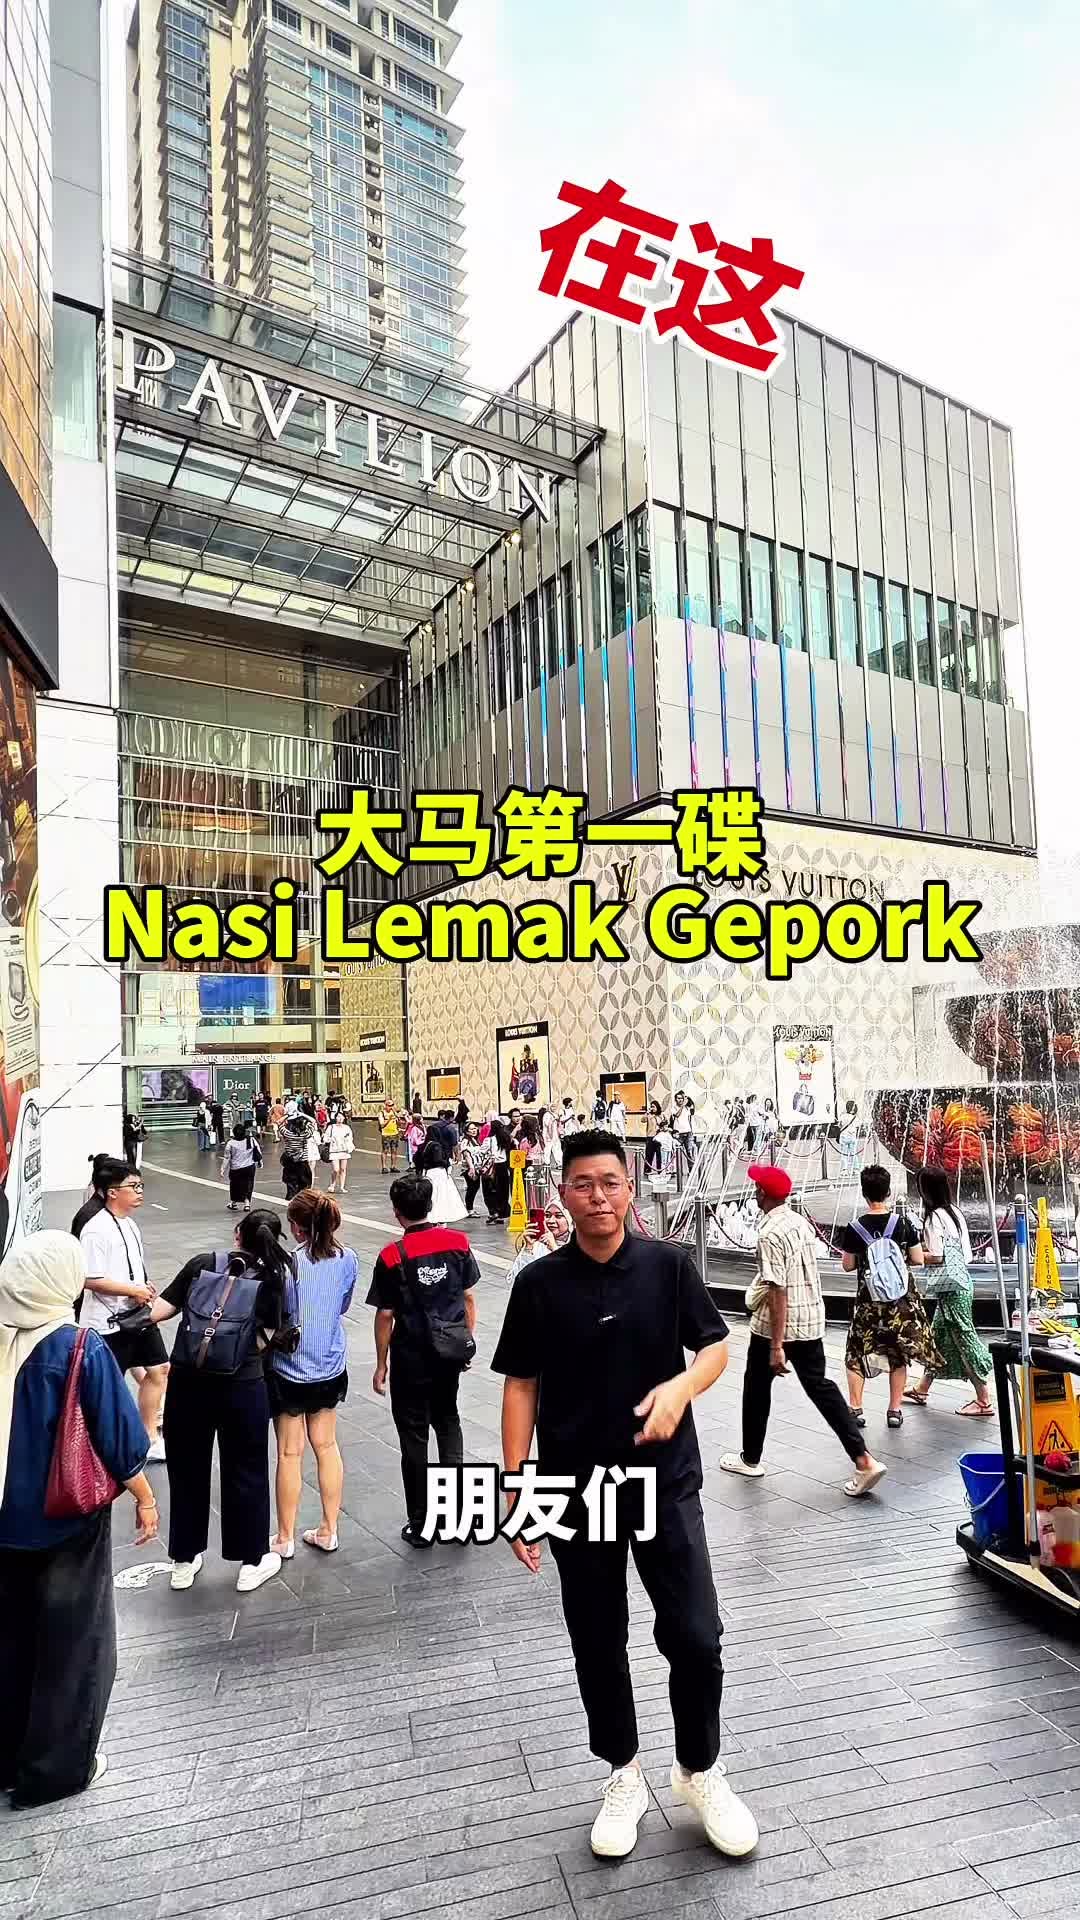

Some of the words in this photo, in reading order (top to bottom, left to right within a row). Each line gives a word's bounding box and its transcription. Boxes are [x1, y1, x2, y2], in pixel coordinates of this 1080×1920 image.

[113, 326, 557, 522] PAVILION
[782, 870, 887, 901] VUITTON
[223, 1079, 250, 1091] Dior
